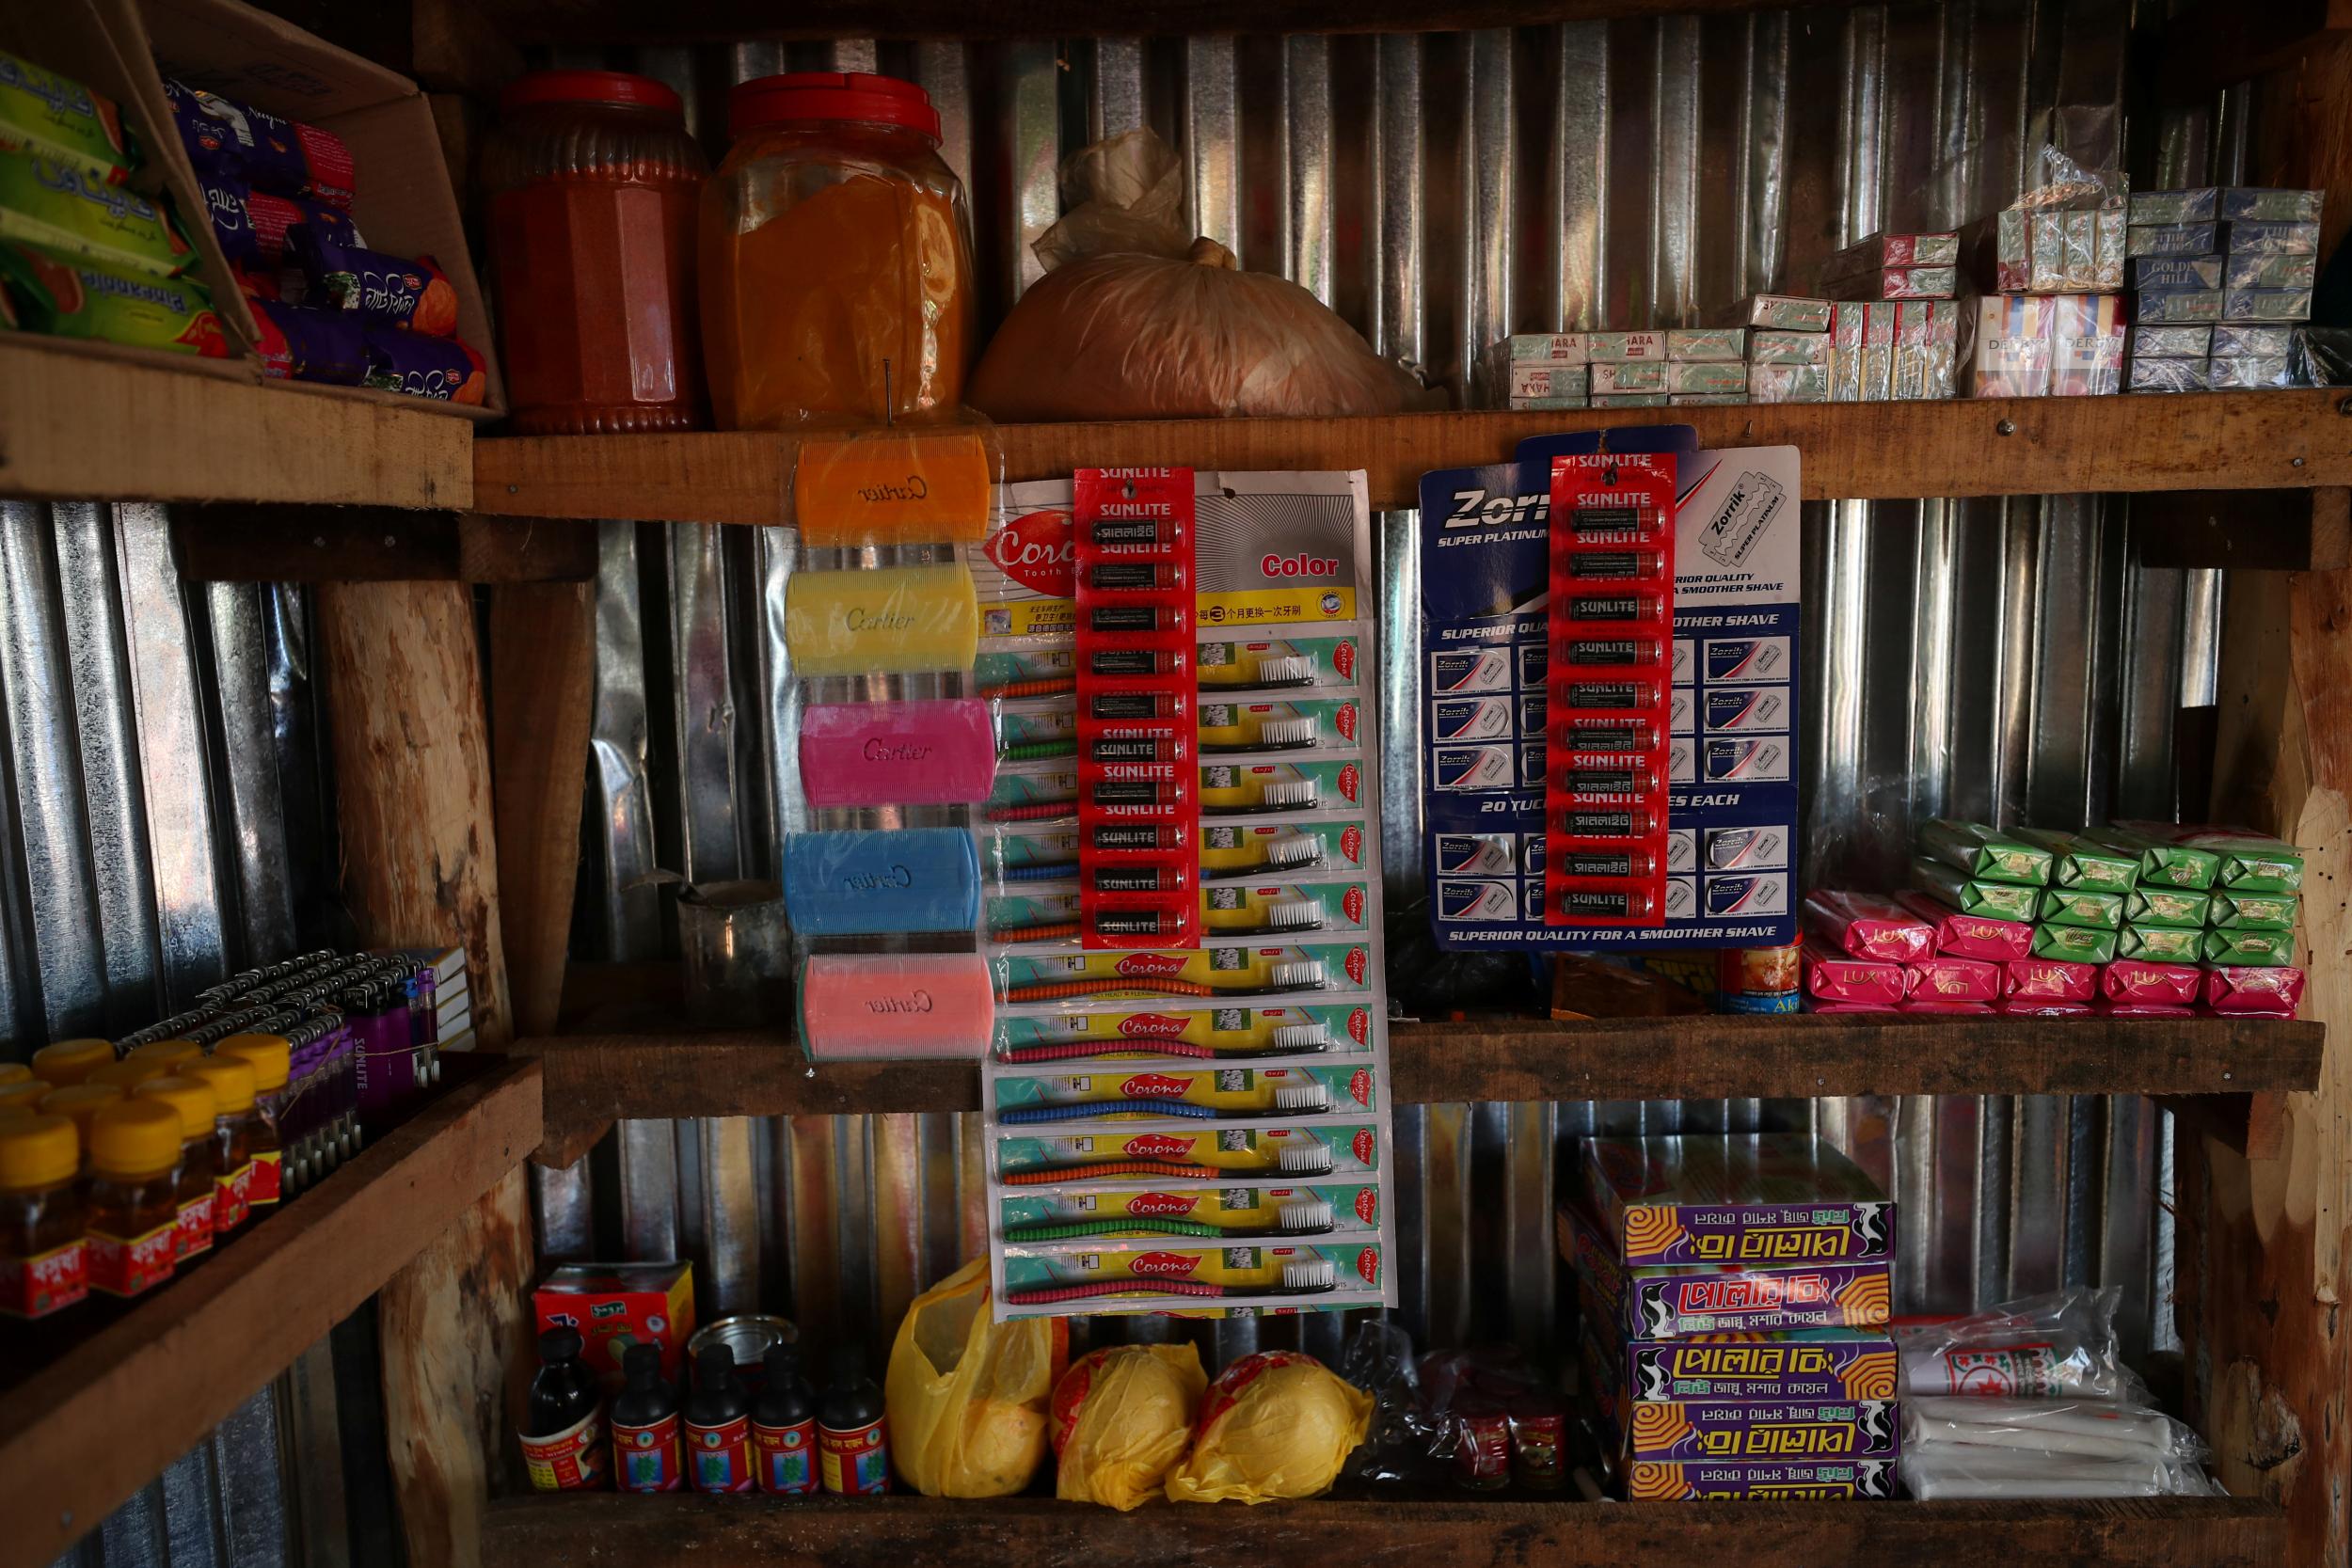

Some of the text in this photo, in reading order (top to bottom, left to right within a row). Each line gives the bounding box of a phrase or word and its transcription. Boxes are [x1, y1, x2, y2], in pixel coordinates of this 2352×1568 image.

[2161, 274, 2191, 284] HILL
[1579, 454, 1652, 467] SUNLITE
[1100, 467, 1171, 479] SUNLITE
[1577, 492, 1651, 506] SUNLITE
[1101, 503, 1171, 516] SUNLITE
[1711, 490, 1745, 535] Zorrik
[1735, 496, 1779, 559] SUPER PLATINUM
[1438, 533, 1482, 547] SUPER
[1577, 531, 1650, 545] SUNLITE
[995, 530, 1077, 565] Coro
[1101, 543, 1172, 554] SUNLITE
[1261, 552, 1340, 578] Color
[1024, 568, 1062, 578] Tooth
[1705, 573, 1755, 583] QUALITY
[1681, 584, 1745, 594] SMOOTHER
[1745, 583, 1784, 592] SHAVE
[1581, 601, 1636, 613] SUNLITE
[847, 608, 915, 632] Cartier
[1673, 613, 1779, 627] OTHER SHAVE
[1441, 624, 1516, 640] SUPERIOR
[1579, 642, 1633, 654] SUNLITE
[1340, 641, 1349, 676] Corona
[1342, 703, 1351, 738] Corona
[865, 738, 932, 764] Cartier
[1101, 744, 1154, 755] SUNLITE
[1573, 754, 1645, 768] SUNLITE
[1104, 766, 1175, 778] SUNLITE
[1344, 764, 1354, 800] Corona
[1573, 793, 1645, 804] SUNLITE
[1690, 794, 1740, 806] EACH
[1104, 804, 1176, 816] SUNLITE
[1481, 800, 1507, 813] 20
[1102, 832, 1155, 844] SUNLITE
[1346, 825, 1356, 861] Corona
[1103, 879, 1156, 890] SUNLITE
[1349, 886, 1359, 922] Corona
[1573, 894, 1626, 905] SUNLITE
[1104, 921, 1157, 932] SUNLITE
[1971, 925, 2004, 940] LUX
[1449, 926, 1777, 942] SUPERIOR QUALITY FOR A SMOOTHER SHAVE
[1871, 927, 1905, 943] LUX
[1119, 960, 1179, 974] Corona
[1351, 946, 1360, 983] Corona
[1843, 970, 1879, 985] LUX
[2030, 967, 2065, 982] LUX
[2133, 969, 2168, 986] LUX
[1121, 1021, 1182, 1034] Corona
[1354, 1007, 1363, 1043] Corona
[1124, 1082, 1184, 1095] Corona
[1357, 1069, 1367, 1104] Corona
[1127, 1142, 1187, 1155] Corona
[1359, 1128, 1369, 1164] Corona
[1130, 1200, 1190, 1213] Corona
[1361, 1187, 1372, 1223] Corona
[1694, 1212, 1737, 1225] কয়েল
[1742, 1211, 1776, 1225] মশার
[1812, 1209, 1851, 1226] নিউ
[1690, 1226, 1851, 1259] পোলার কিং
[1133, 1259, 1193, 1273] Corona
[1364, 1246, 1374, 1281] Corona
[1677, 1274, 1831, 1316] পোলার কিং
[1677, 1315, 1715, 1333] নিউ
[1749, 1312, 1783, 1327] মশার
[1788, 1310, 1827, 1325] কয়েল
[1672, 1347, 1835, 1379] পোলার কিং
[1673, 1379, 1711, 1396] নিউ
[1746, 1381, 1782, 1395] মশার
[1788, 1381, 1829, 1395] কয়েল
[1701, 1407, 1742, 1421] কয়েল
[1749, 1407, 1783, 1421] মশার
[1818, 1405, 1856, 1422] নিউ
[1696, 1422, 1856, 1455] পোলার কিং
[1700, 1468, 1741, 1481] কয়েল
[1747, 1467, 1782, 1481] মশার
[1816, 1465, 1854, 1482] নিউ
